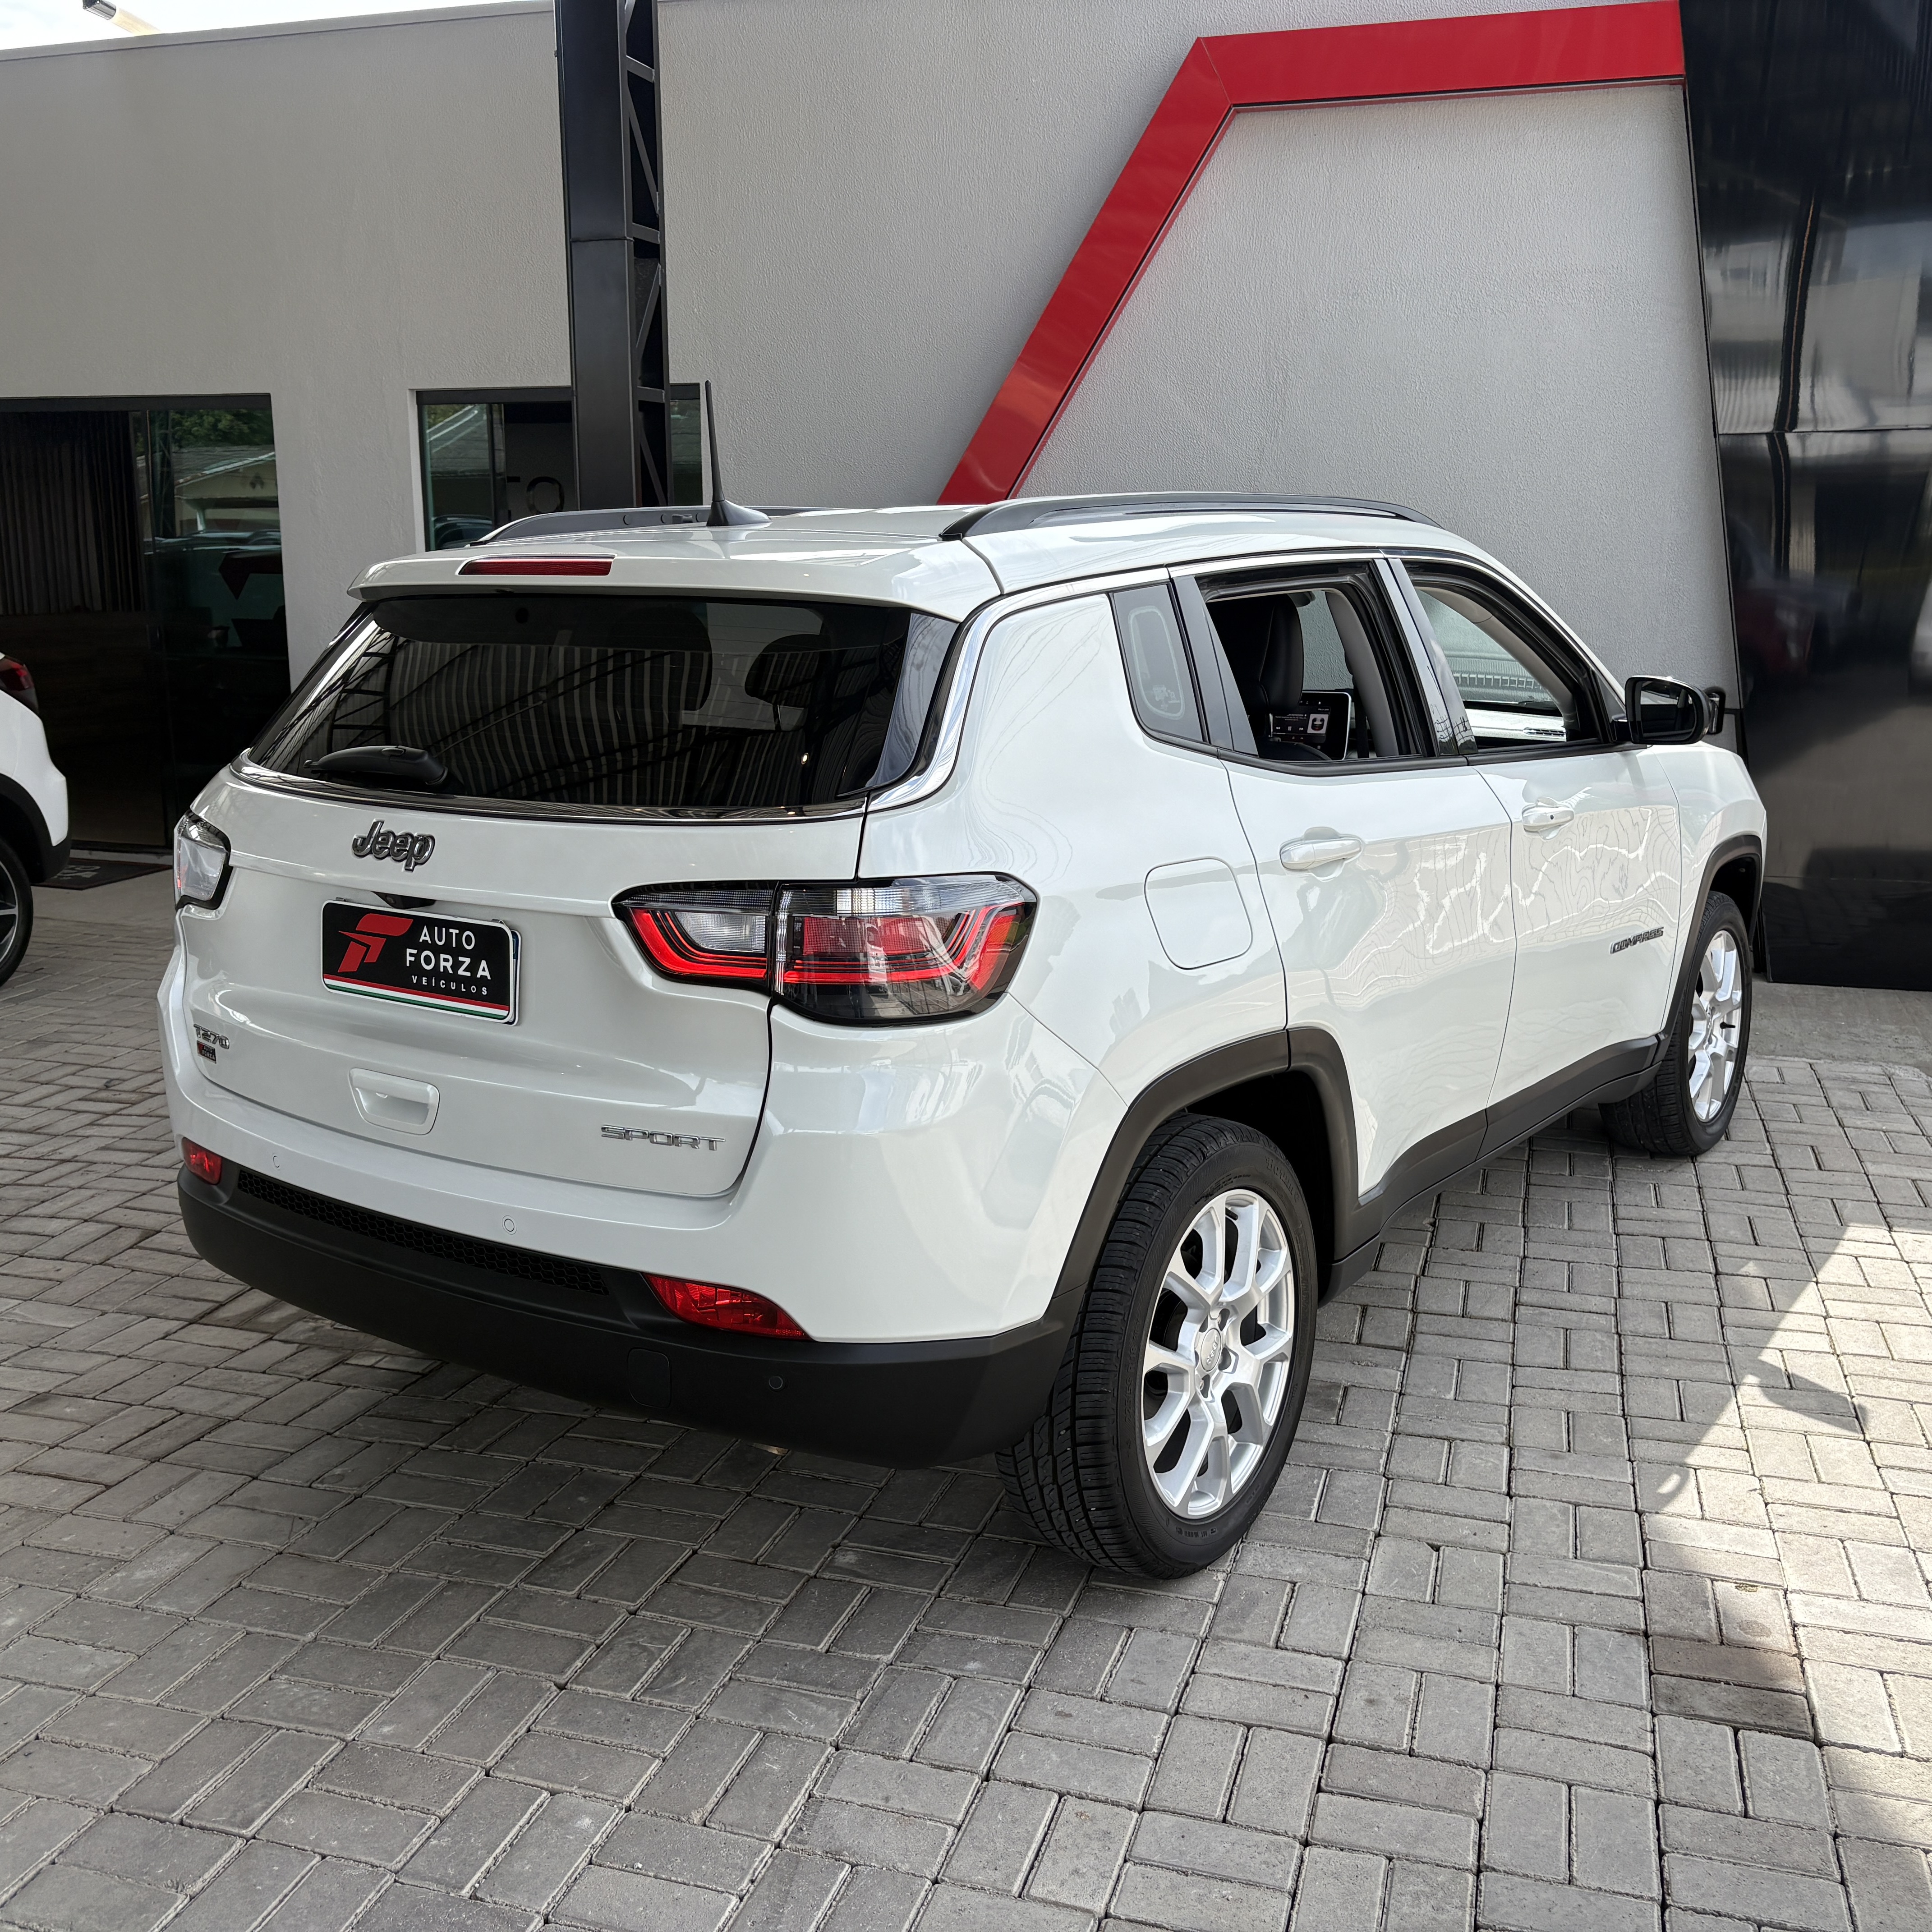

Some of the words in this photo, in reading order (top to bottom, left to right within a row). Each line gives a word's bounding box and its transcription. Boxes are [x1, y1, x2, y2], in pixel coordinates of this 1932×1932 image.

[352, 819, 436, 872] Jeep
[419, 925, 475, 950] AUTO
[1610, 926, 1664, 954] COMPASS
[406, 948, 492, 980] FORZA
[412, 975, 488, 995] VEÍCULOS
[193, 1023, 230, 1050] T270
[601, 1124, 726, 1151] SPORT
